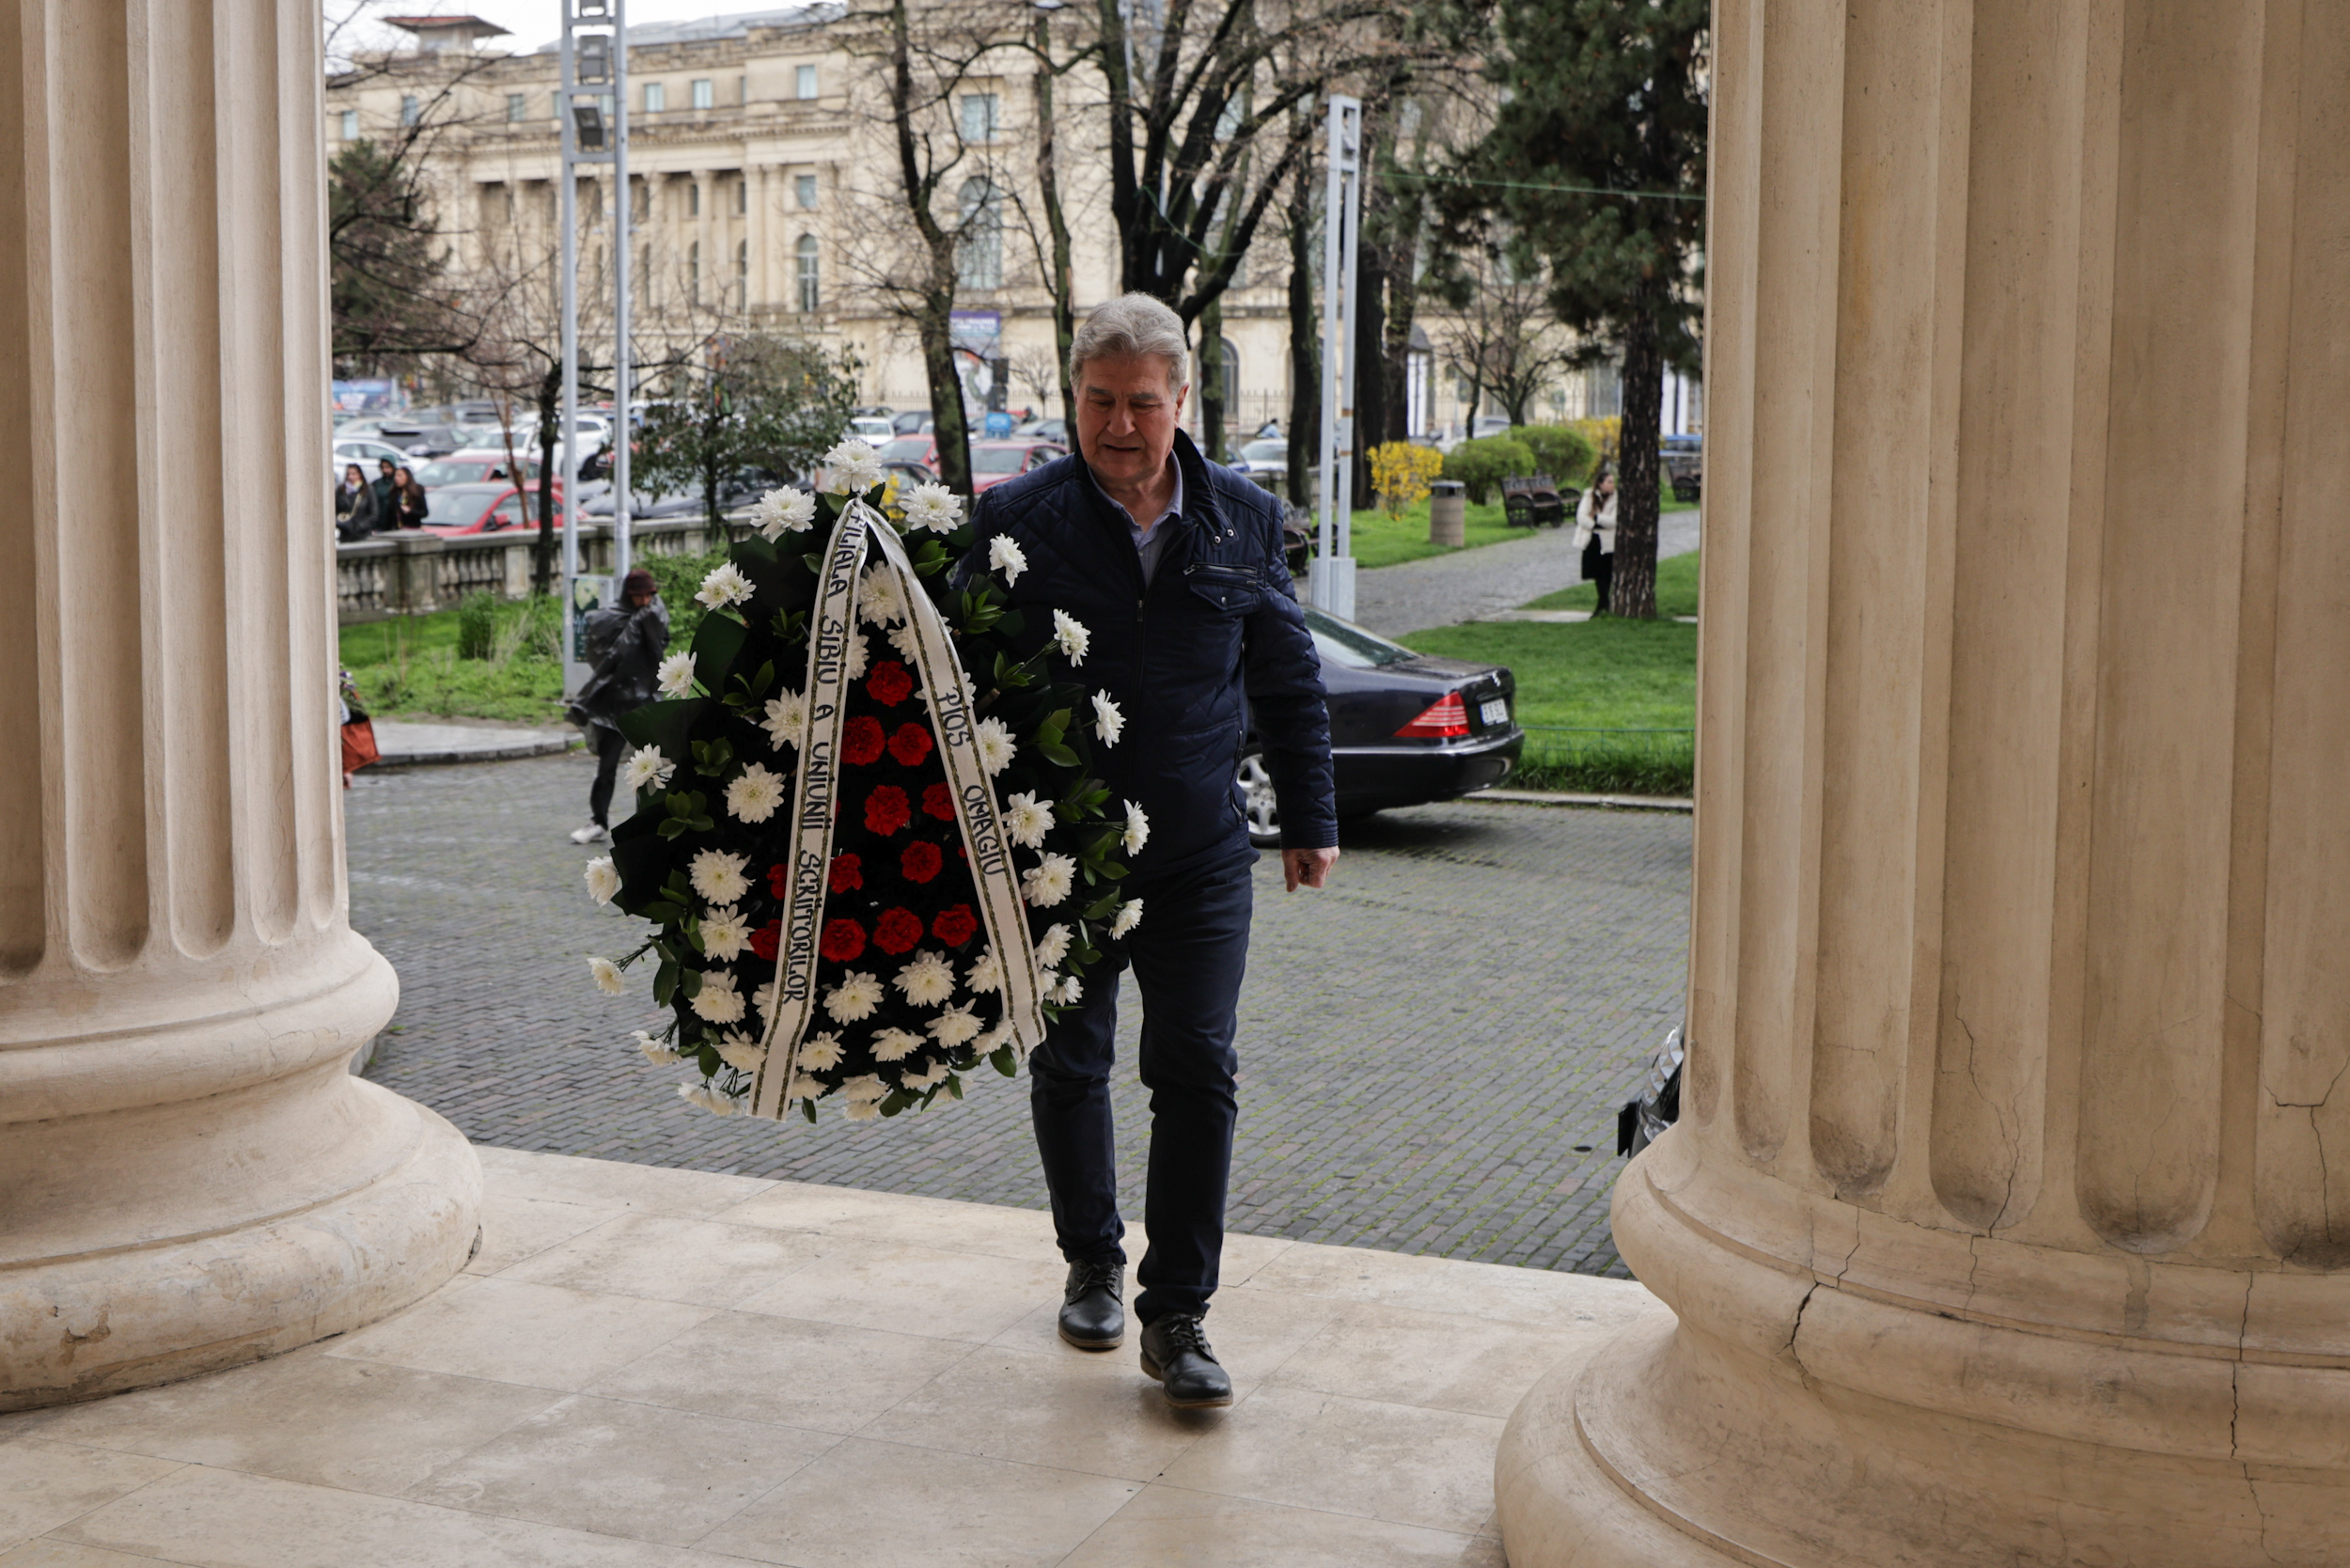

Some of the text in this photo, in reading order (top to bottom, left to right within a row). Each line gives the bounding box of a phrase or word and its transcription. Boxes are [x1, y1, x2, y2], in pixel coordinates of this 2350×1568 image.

[783, 514, 867, 1004] FILIALA SIBIU A UNIUNII SCRIITORILOR
[937, 685, 1008, 876] PIOS OMAGIU
